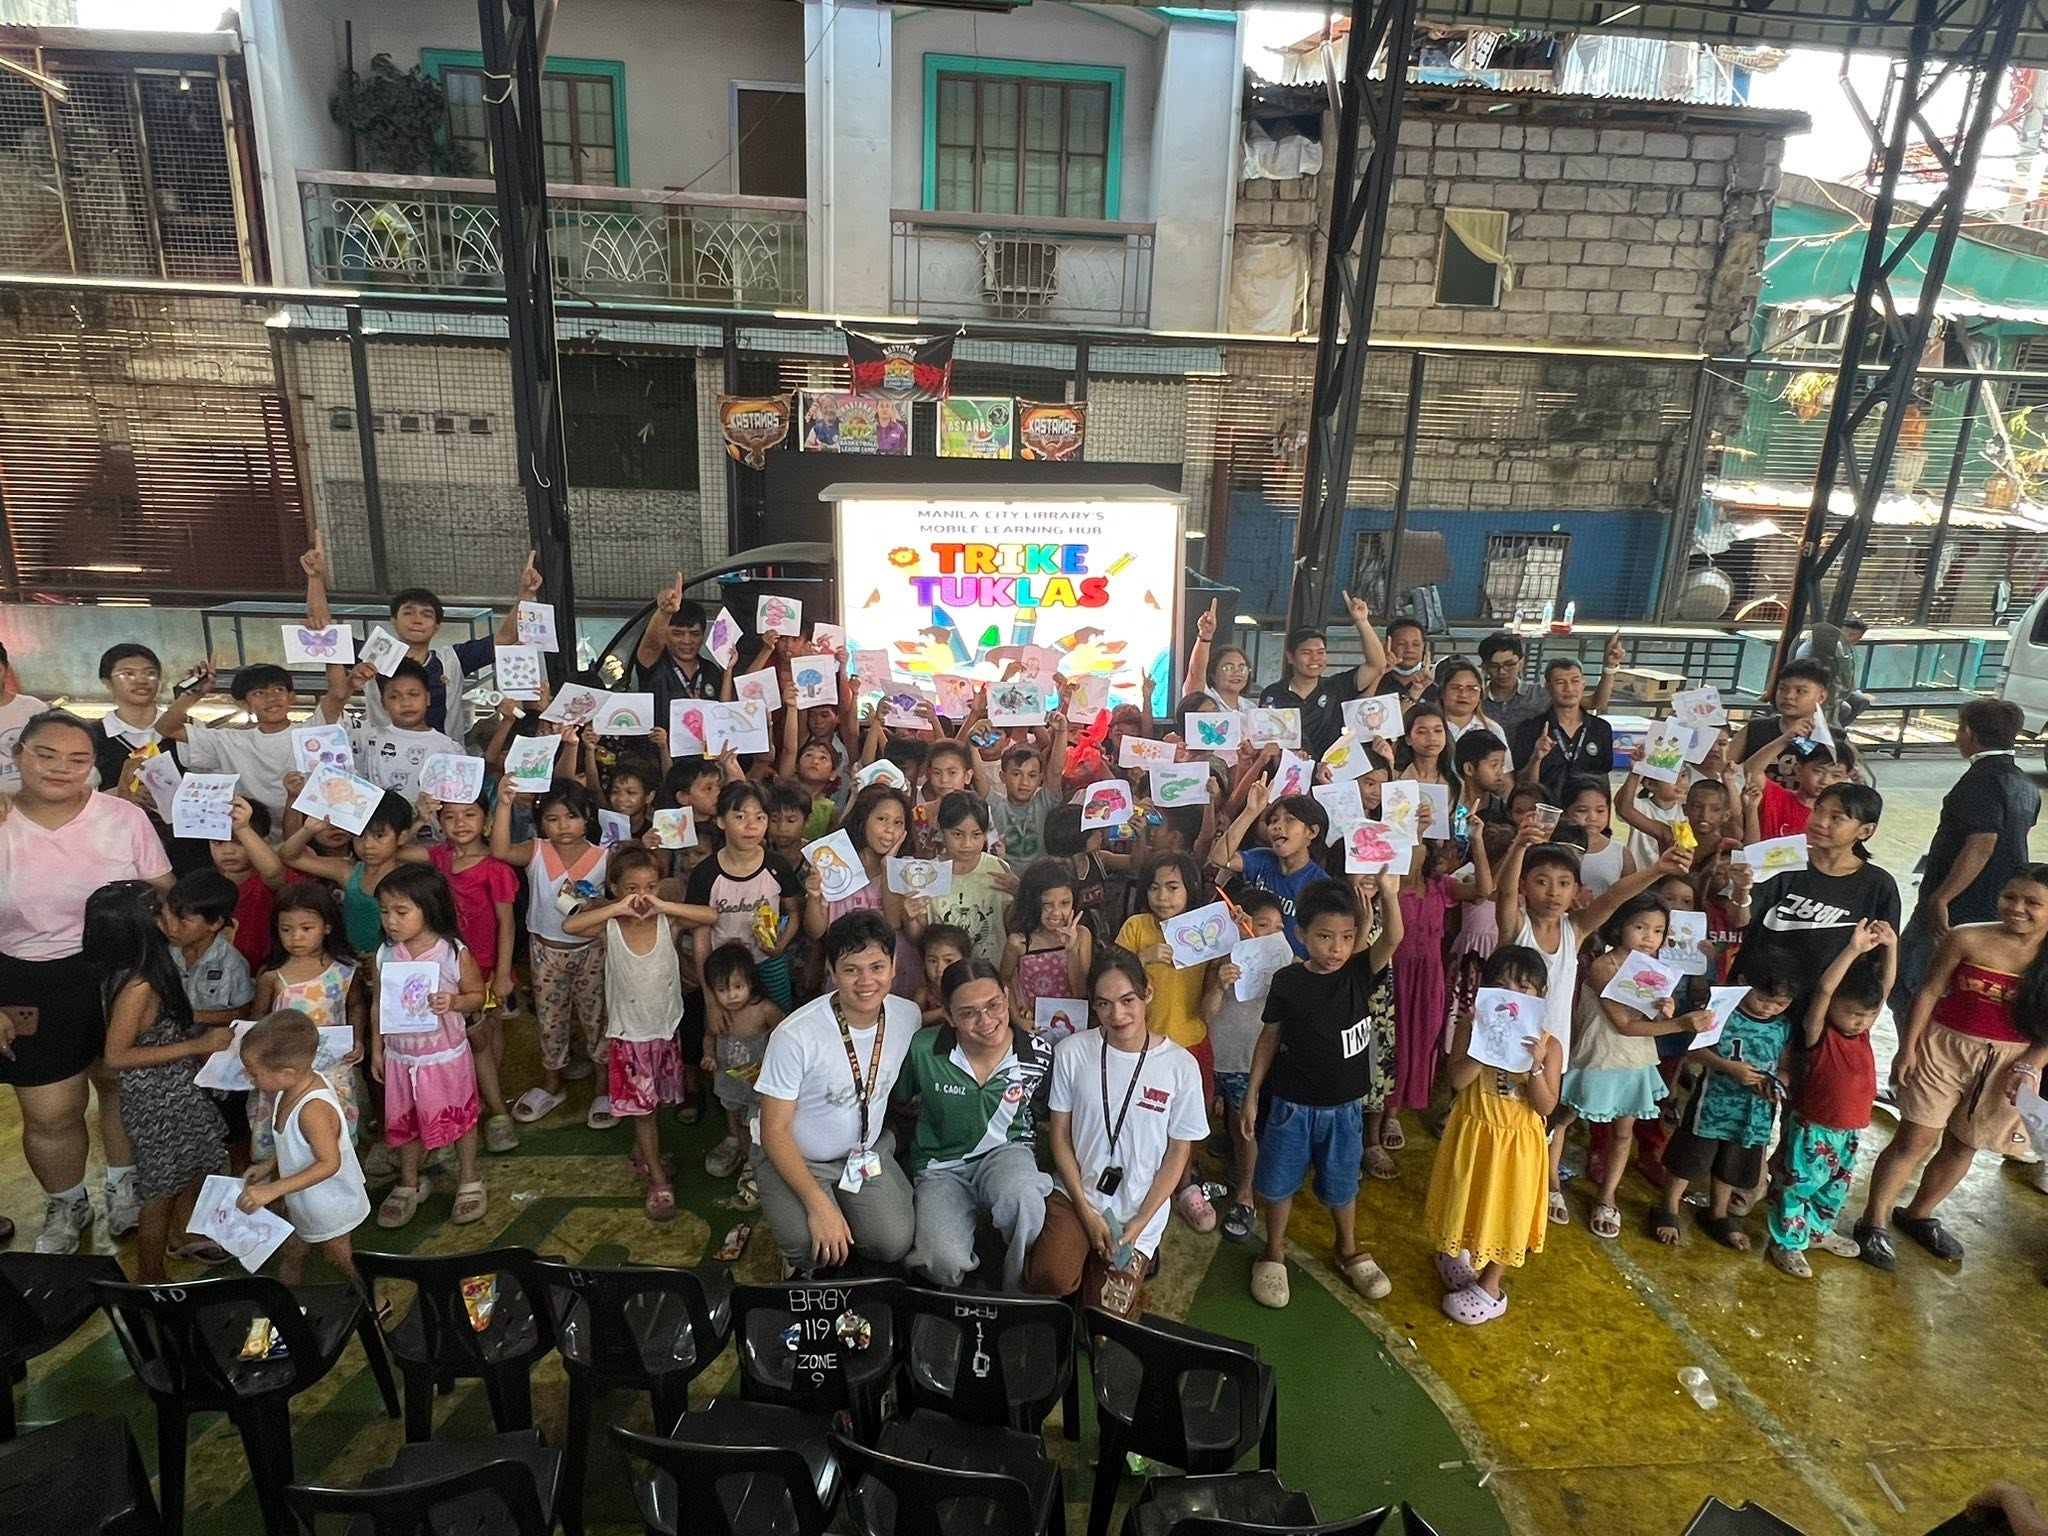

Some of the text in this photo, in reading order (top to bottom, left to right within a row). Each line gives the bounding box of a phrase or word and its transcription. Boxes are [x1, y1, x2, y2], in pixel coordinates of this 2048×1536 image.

[918, 510, 1105, 521] MANILA CITY LIBRARY'S
[920, 525, 1102, 535] MOBILE LEARNING HUB
[931, 542, 1089, 575] TRIKE
[909, 576, 1110, 608] TUKLAS
[943, 1083, 966, 1096] CADIZ
[789, 1288, 852, 1312] BRGY
[804, 1318, 830, 1341] 119
[797, 1353, 838, 1370] ZONE
[811, 1371, 825, 1389] 9
